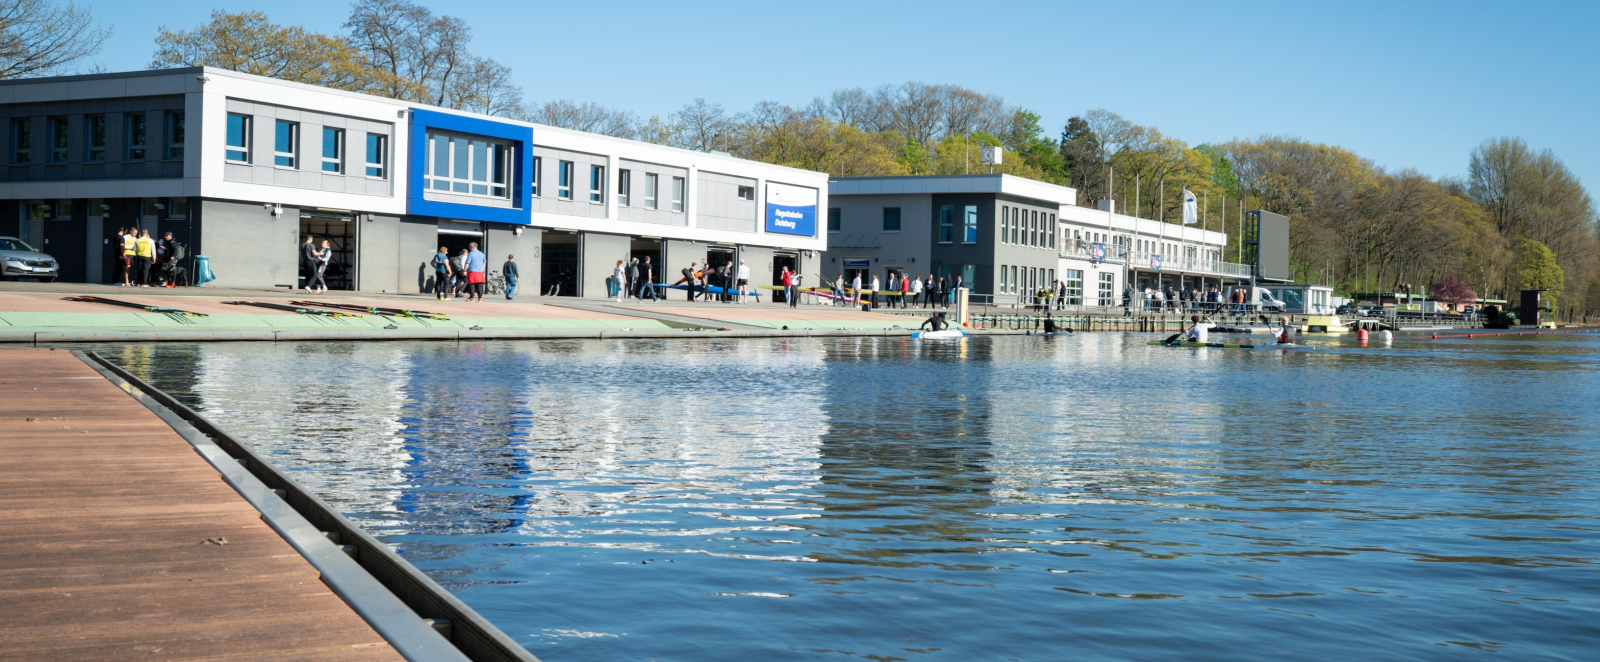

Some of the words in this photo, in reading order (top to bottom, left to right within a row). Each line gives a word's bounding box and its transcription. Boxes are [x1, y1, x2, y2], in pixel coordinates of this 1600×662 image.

[775, 209, 803, 219] Regattabahn
[775, 219, 796, 229] Duisburg
[534, 246, 540, 259] 3
[624, 252, 629, 262] 4
[768, 262, 773, 272] 6
